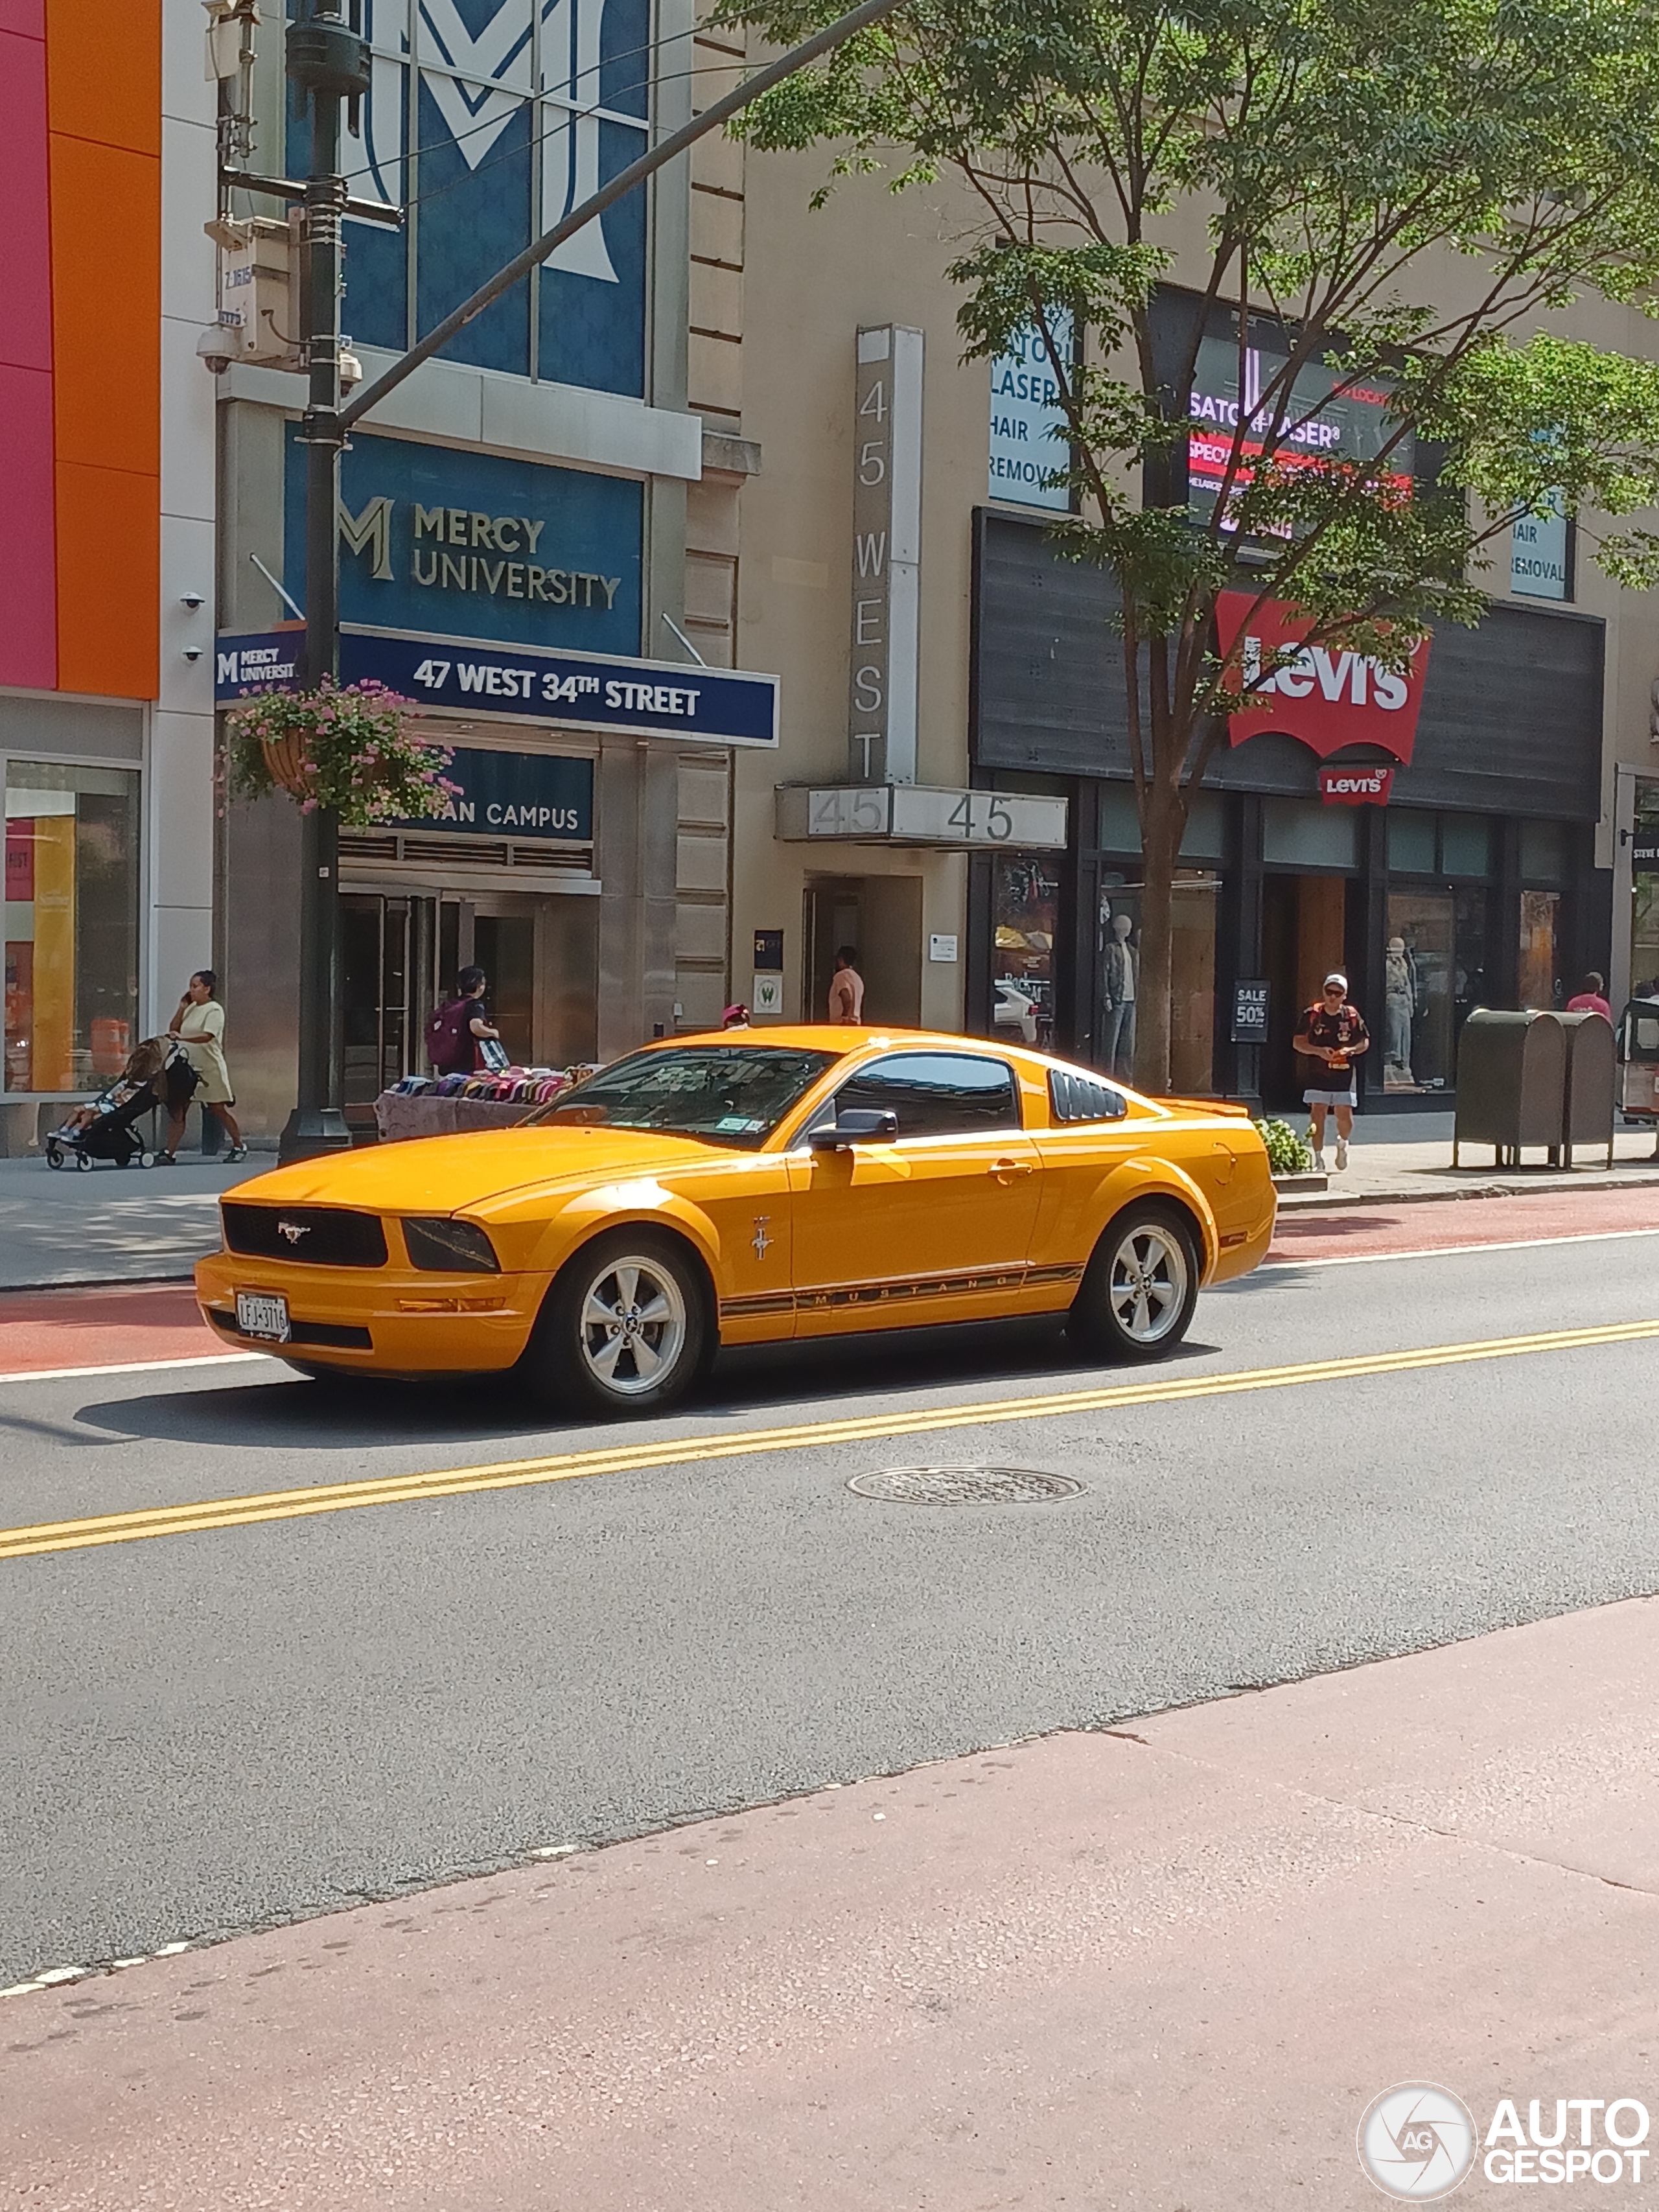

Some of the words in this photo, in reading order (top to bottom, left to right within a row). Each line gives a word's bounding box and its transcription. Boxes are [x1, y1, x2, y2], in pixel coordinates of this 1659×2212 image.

[414, 503, 545, 553] MERCY
[413, 549, 621, 610] UNIVERSITY
[1511, 555, 1566, 582] EMOVAL
[240, 647, 279, 665] MERCY
[854, 531, 885, 778] WEST
[240, 663, 297, 682] UNIVERSIT
[413, 659, 451, 688] 47
[457, 663, 537, 698] WEST
[542, 673, 599, 703] 34TH
[605, 681, 701, 716] STREET
[486, 803, 578, 830] CAMPUS
[812, 790, 883, 834] 45
[947, 793, 1013, 841] 45
[1237, 989, 1267, 1001] SALE
[1236, 1006, 1265, 1023] 50%
[815, 1276, 1006, 1305] MUSTANG
